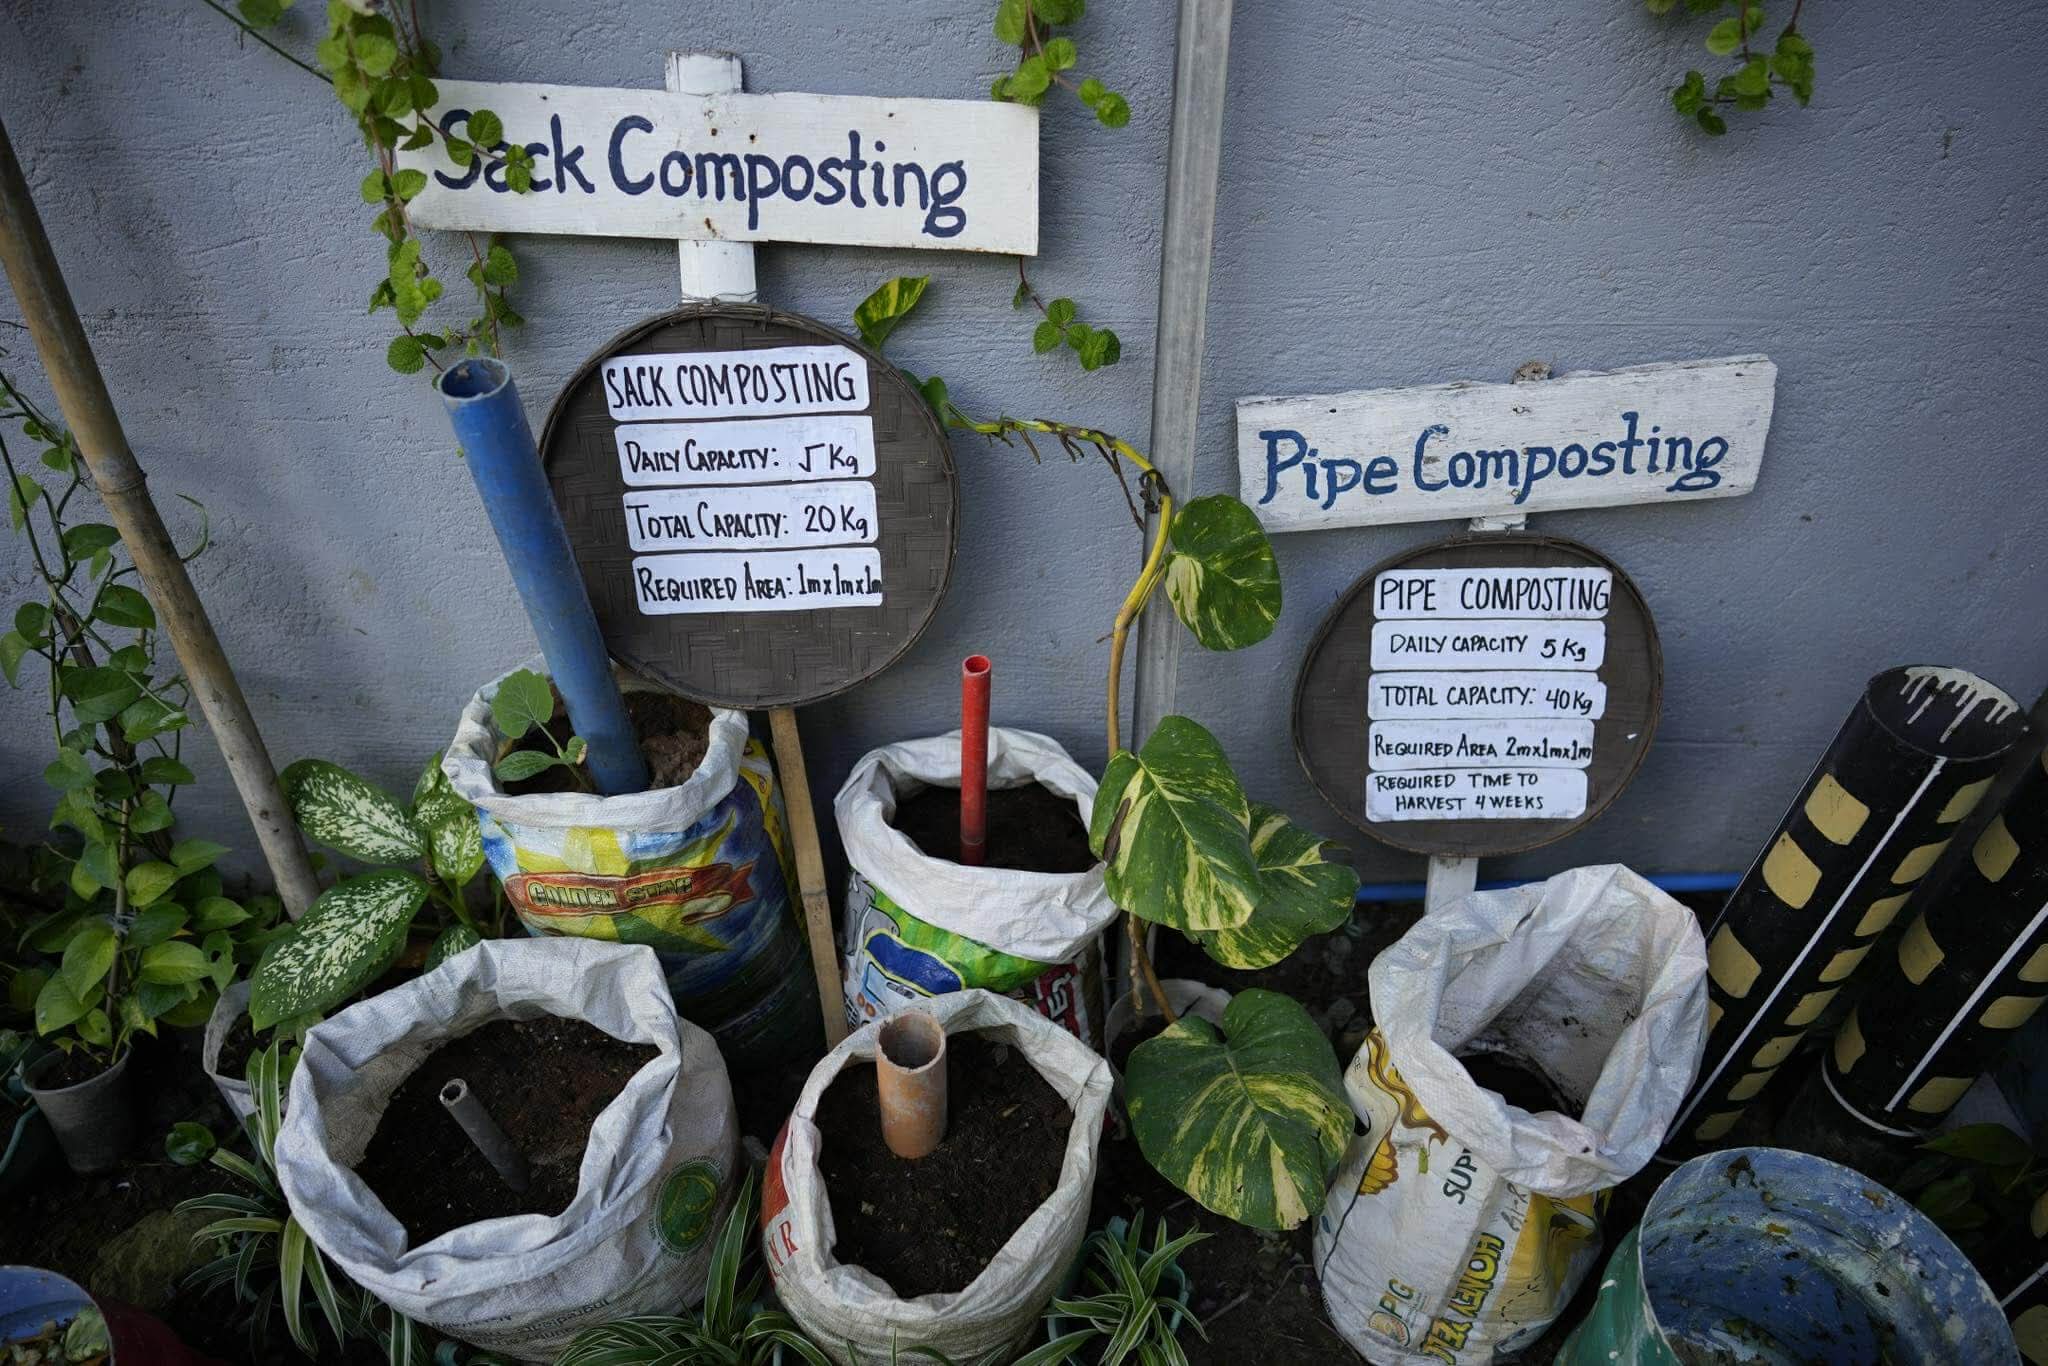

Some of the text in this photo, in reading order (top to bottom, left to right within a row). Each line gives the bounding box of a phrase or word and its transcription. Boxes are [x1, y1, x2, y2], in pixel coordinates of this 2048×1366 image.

[608, 115, 967, 238] Composting
[606, 361, 856, 409] SACK COMPOSTING
[624, 440, 681, 473] DAILY
[685, 438, 780, 470] CAPACITY:
[829, 443, 859, 475] Kg
[1258, 411, 1730, 511] Pipe Composting
[626, 503, 695, 540] TOTAL
[697, 501, 789, 539] CAPACITY:
[804, 504, 836, 533] 20
[637, 567, 737, 602] REQUIRED
[743, 561, 793, 601] AREA:
[1379, 577, 1610, 612] PIPE COMPOSTING
[1390, 634, 1587, 662] DAILY CAPACITY 5 Kg
[1380, 685, 1438, 707] TOTAL
[1446, 685, 1536, 706] CAPACITY:
[1374, 733, 1453, 757] REQUIRED
[1456, 733, 1498, 758] AREA
[1374, 772, 1539, 792] REQUIRED TIME TO
[1395, 795, 1545, 812] HARVEST 4 WEEKS
[1443, 1148, 1478, 1205] SUP
